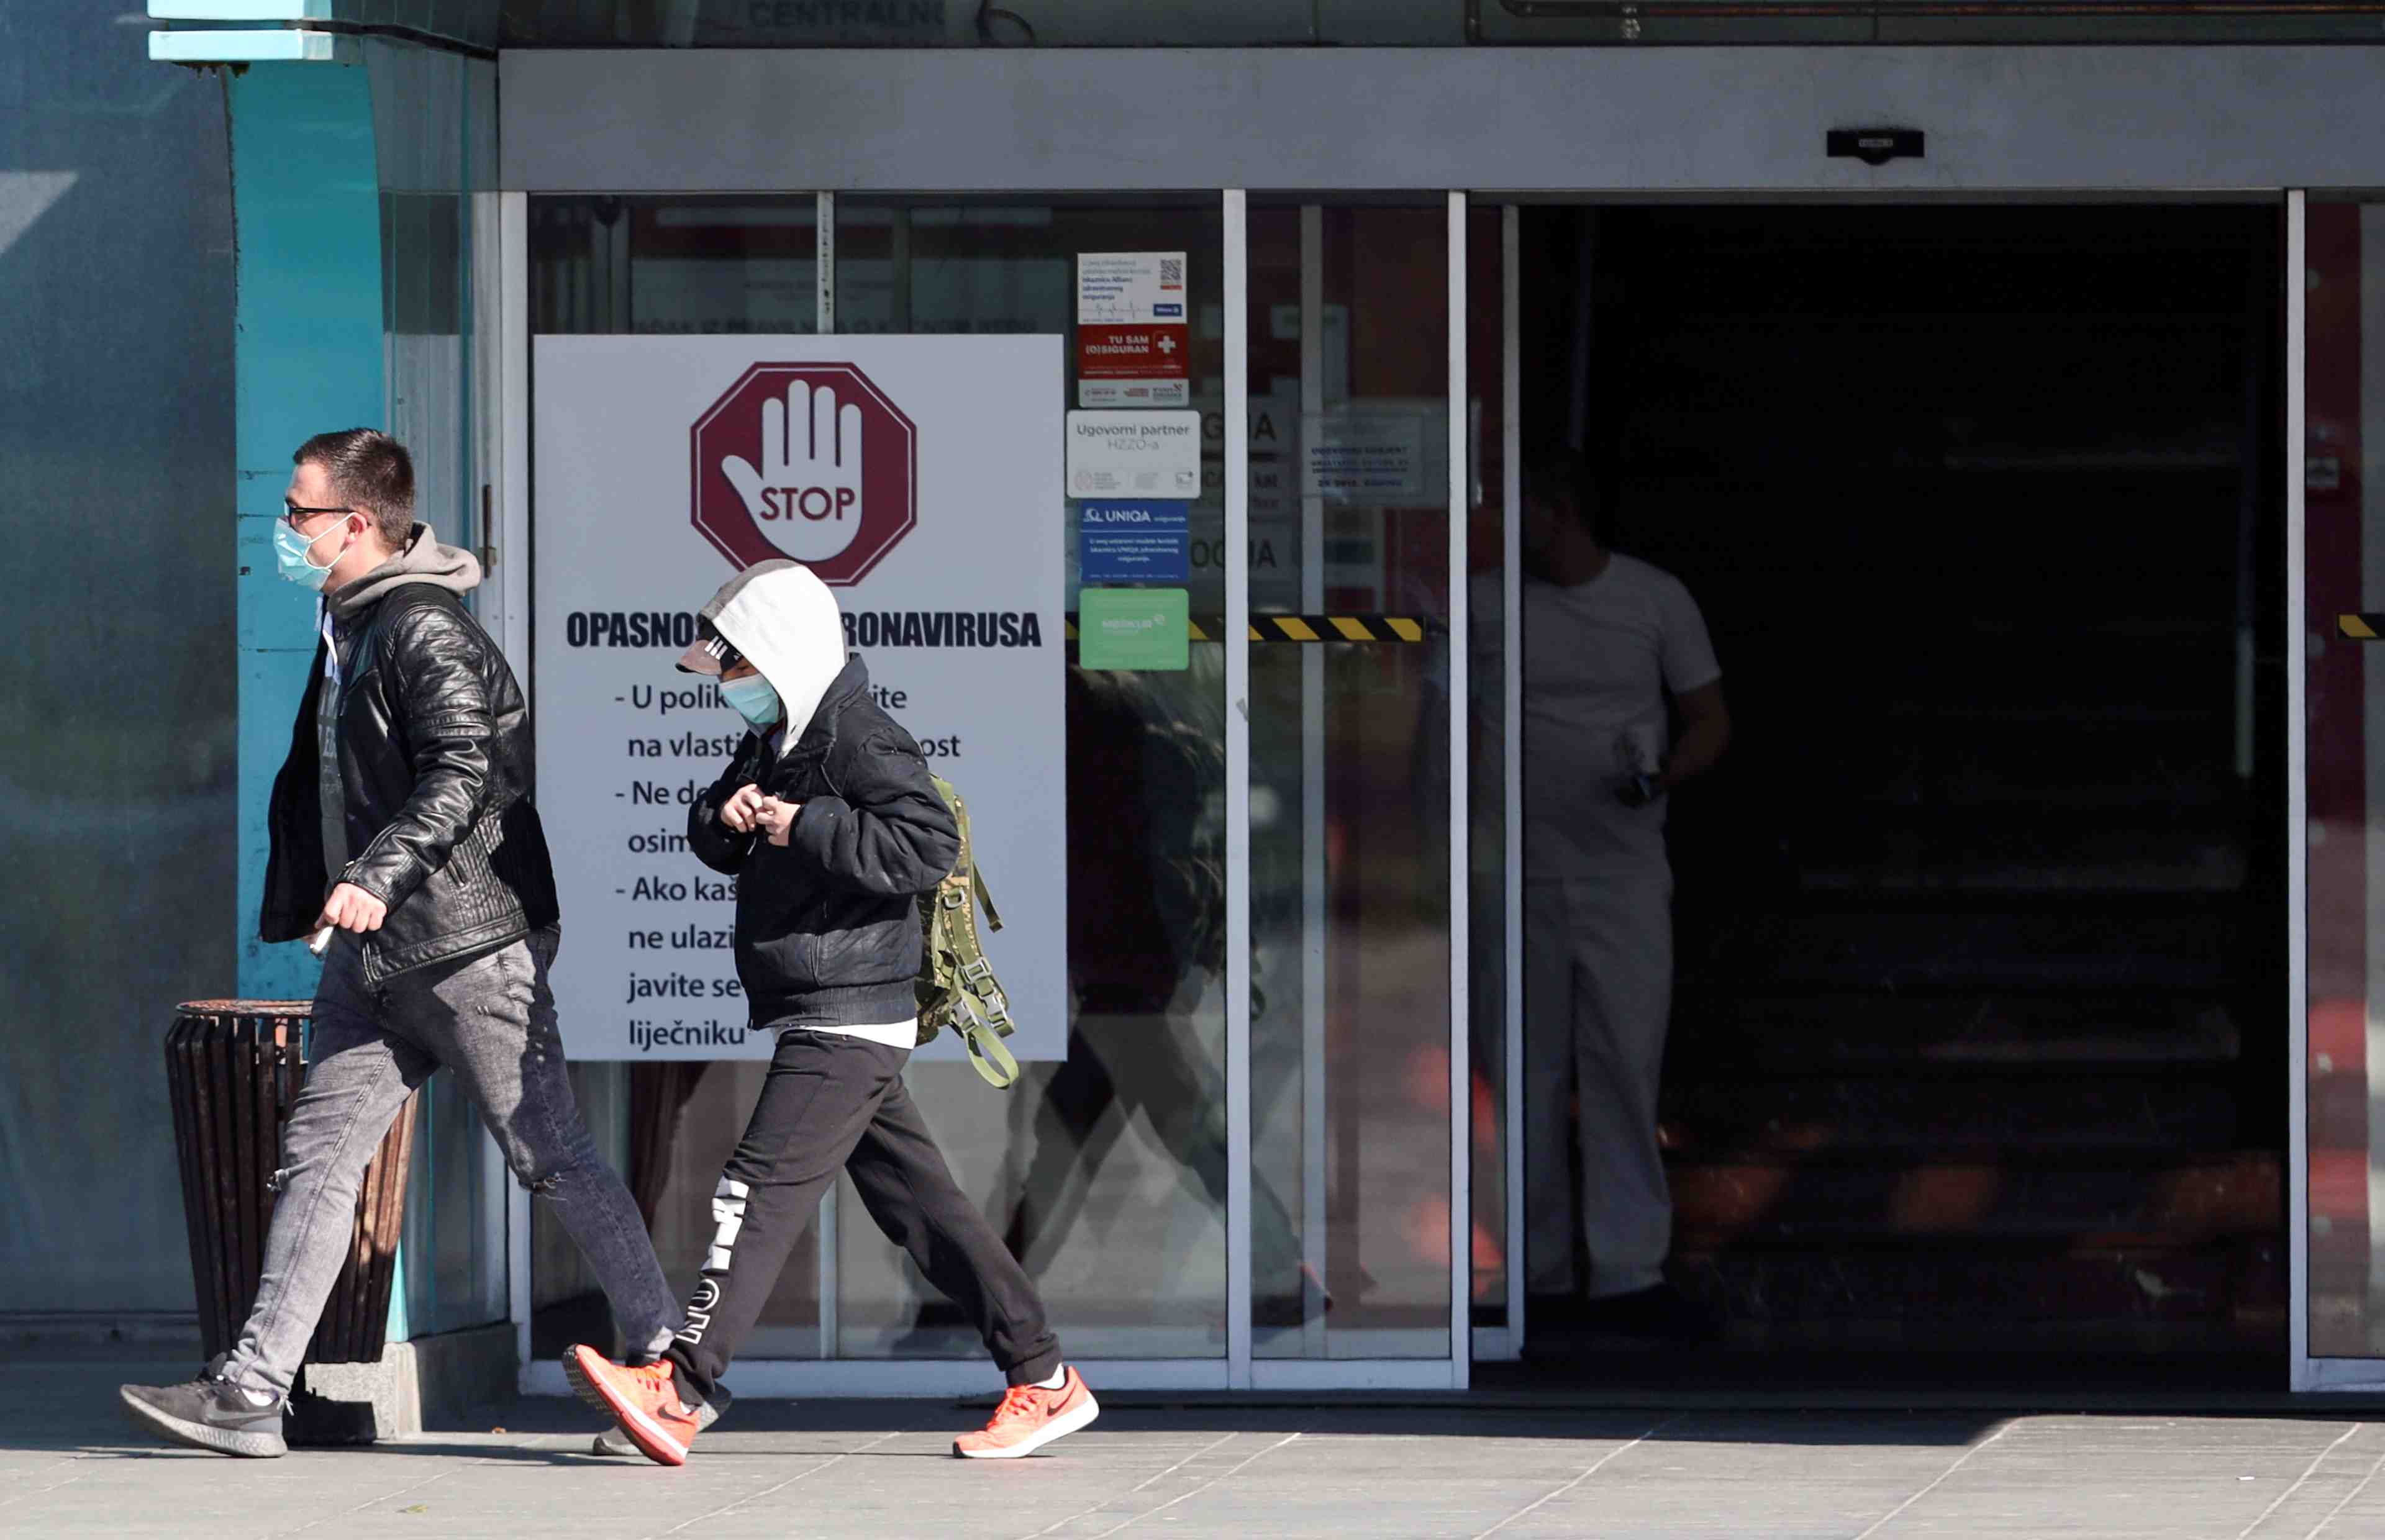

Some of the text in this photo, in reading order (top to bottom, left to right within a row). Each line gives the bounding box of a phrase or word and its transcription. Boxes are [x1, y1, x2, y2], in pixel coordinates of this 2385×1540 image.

[1109, 335, 1149, 344] TU SAM
[1076, 424, 1189, 437] Ugovorni partner
[760, 486, 856, 520] STOP
[1104, 510, 1152, 522] UNIQA
[566, 611, 1042, 648] OPASNO RONAVIRUSA
[632, 685, 652, 709] U
[660, 684, 730, 715] polik
[872, 684, 907, 709] ite
[628, 731, 961, 757] na vlasti ost
[632, 781, 670, 805] Ne
[632, 876, 687, 901] Ako
[694, 875, 738, 902] kaš
[628, 923, 735, 949] ne ulazi
[626, 972, 742, 1004] javite se
[629, 1019, 745, 1052] liječniku
